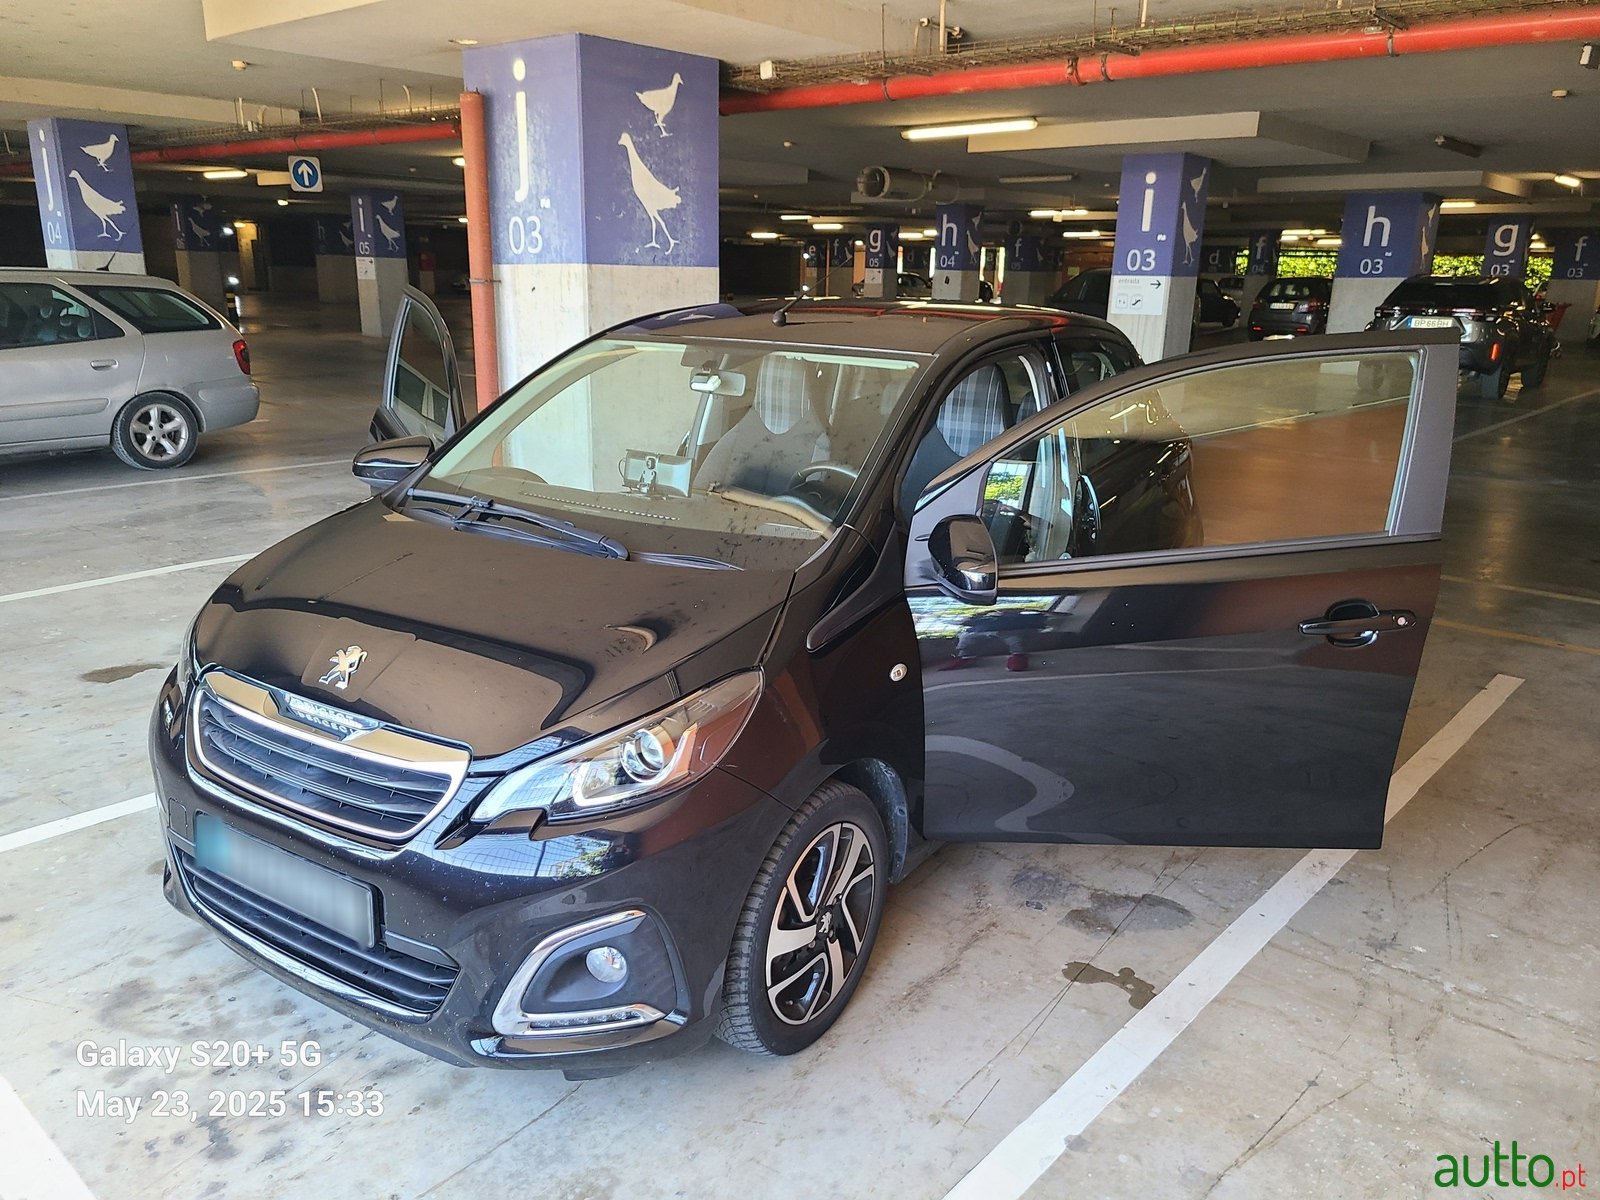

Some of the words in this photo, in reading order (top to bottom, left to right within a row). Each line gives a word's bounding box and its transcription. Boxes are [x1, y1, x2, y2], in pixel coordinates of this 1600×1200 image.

[47, 221, 62, 244] 04
[508, 215, 543, 254] 03
[941, 213, 958, 247] h
[1362, 205, 1392, 247] h
[359, 242, 370, 255] 05
[869, 229, 882, 253] g
[1492, 224, 1519, 257] g
[868, 258, 880, 267] 05
[940, 255, 955, 268] 04
[1126, 249, 1156, 271] 03
[1359, 258, 1384, 275] 03
[1490, 264, 1510, 277] 03
[1567, 267, 1584, 278] 03
